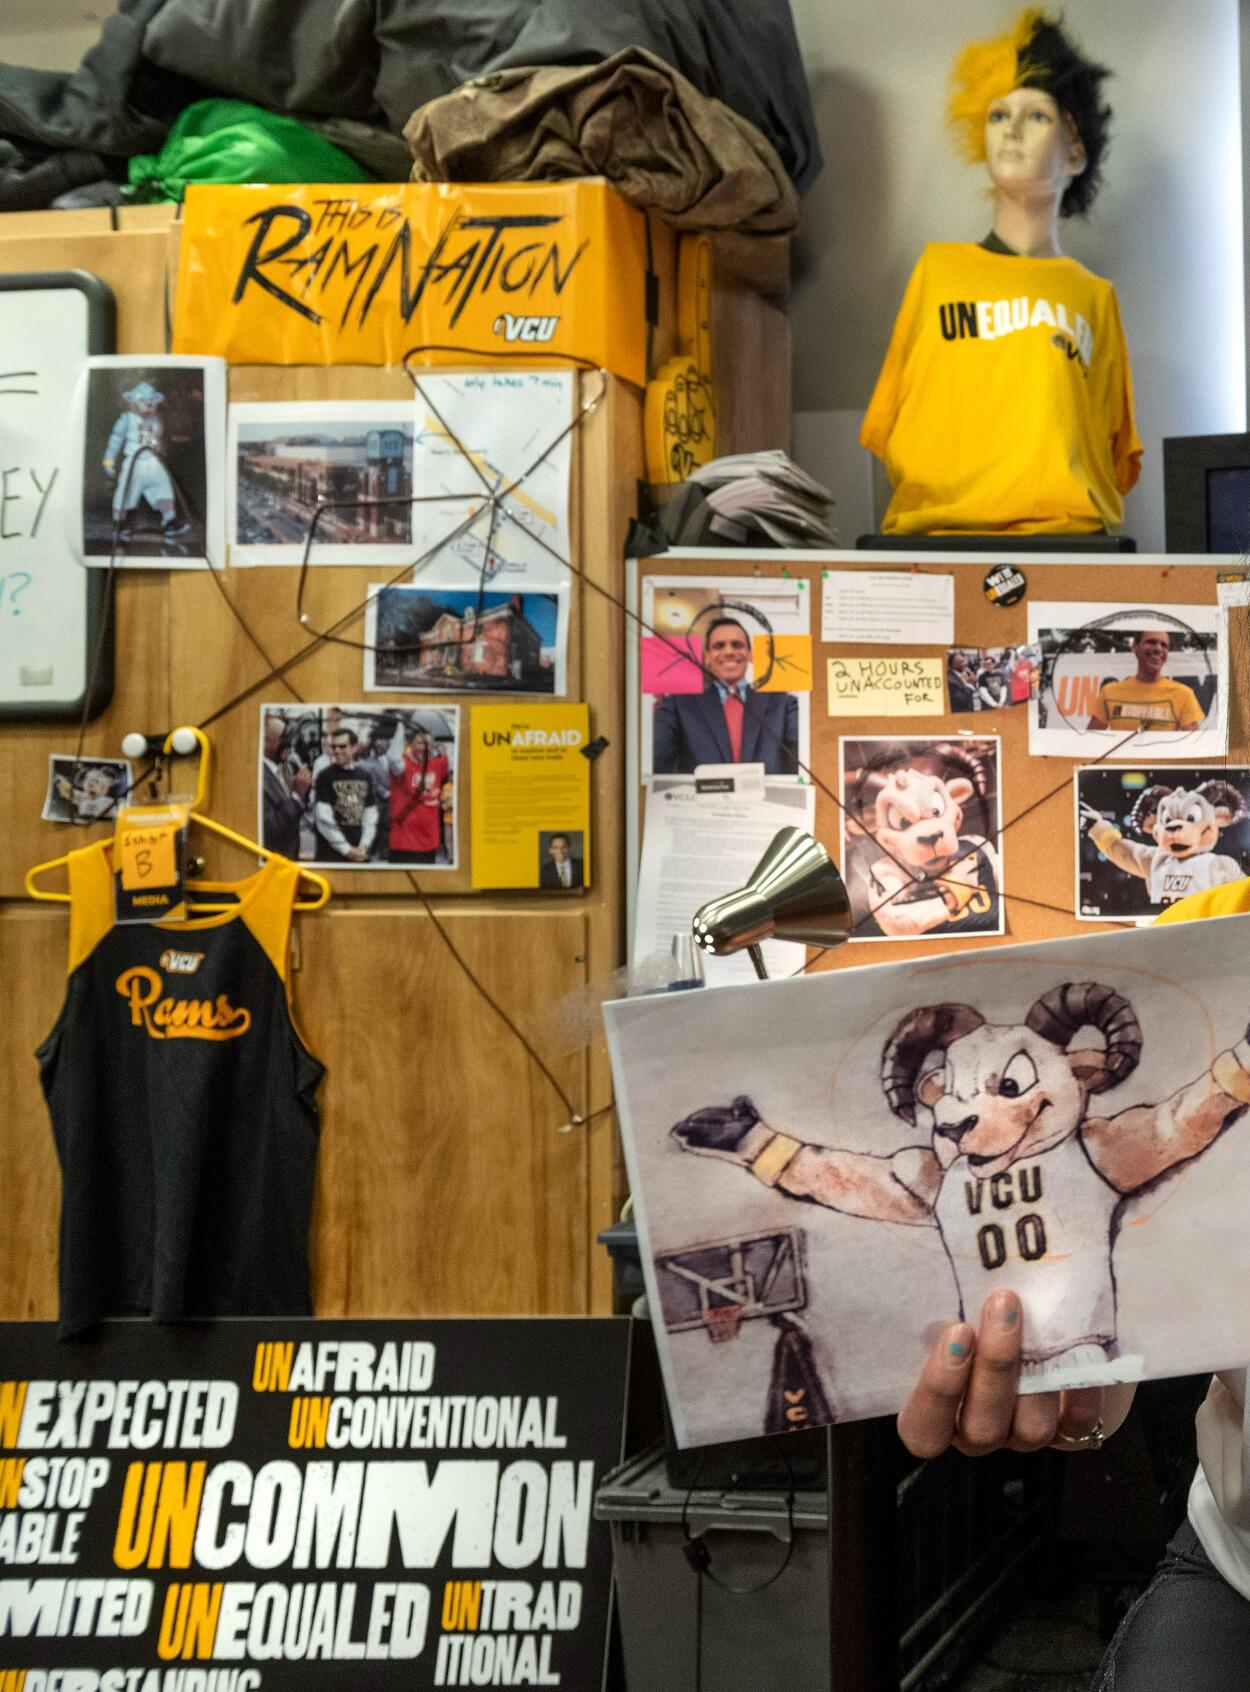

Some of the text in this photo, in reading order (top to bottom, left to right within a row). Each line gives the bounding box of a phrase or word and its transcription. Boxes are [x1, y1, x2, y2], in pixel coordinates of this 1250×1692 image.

[312, 199, 403, 234] THIS IS
[504, 314, 560, 343] VCU
[939, 296, 1093, 368] UNEQUAL
[831, 660, 924, 679] 2 HOURS
[836, 676, 942, 693] UNACCOUNTED
[904, 692, 934, 706] FOR
[483, 729, 582, 747] UNAFRAID
[134, 850, 152, 879] B
[1163, 874, 1194, 892] VCU
[132, 894, 169, 907] MEDIA
[169, 952, 201, 972] VCU
[964, 1165, 1043, 1216] VCU
[252, 1341, 436, 1393] UNAFRAID
[288, 1396, 567, 1450] UNCONVENTIONAL
[113, 1459, 595, 1571] UNCOMMON
[157, 1581, 431, 1661] UNEQUALED
[441, 1580, 583, 1632] UNTRAD
[433, 1635, 561, 1687] ITIONAL
